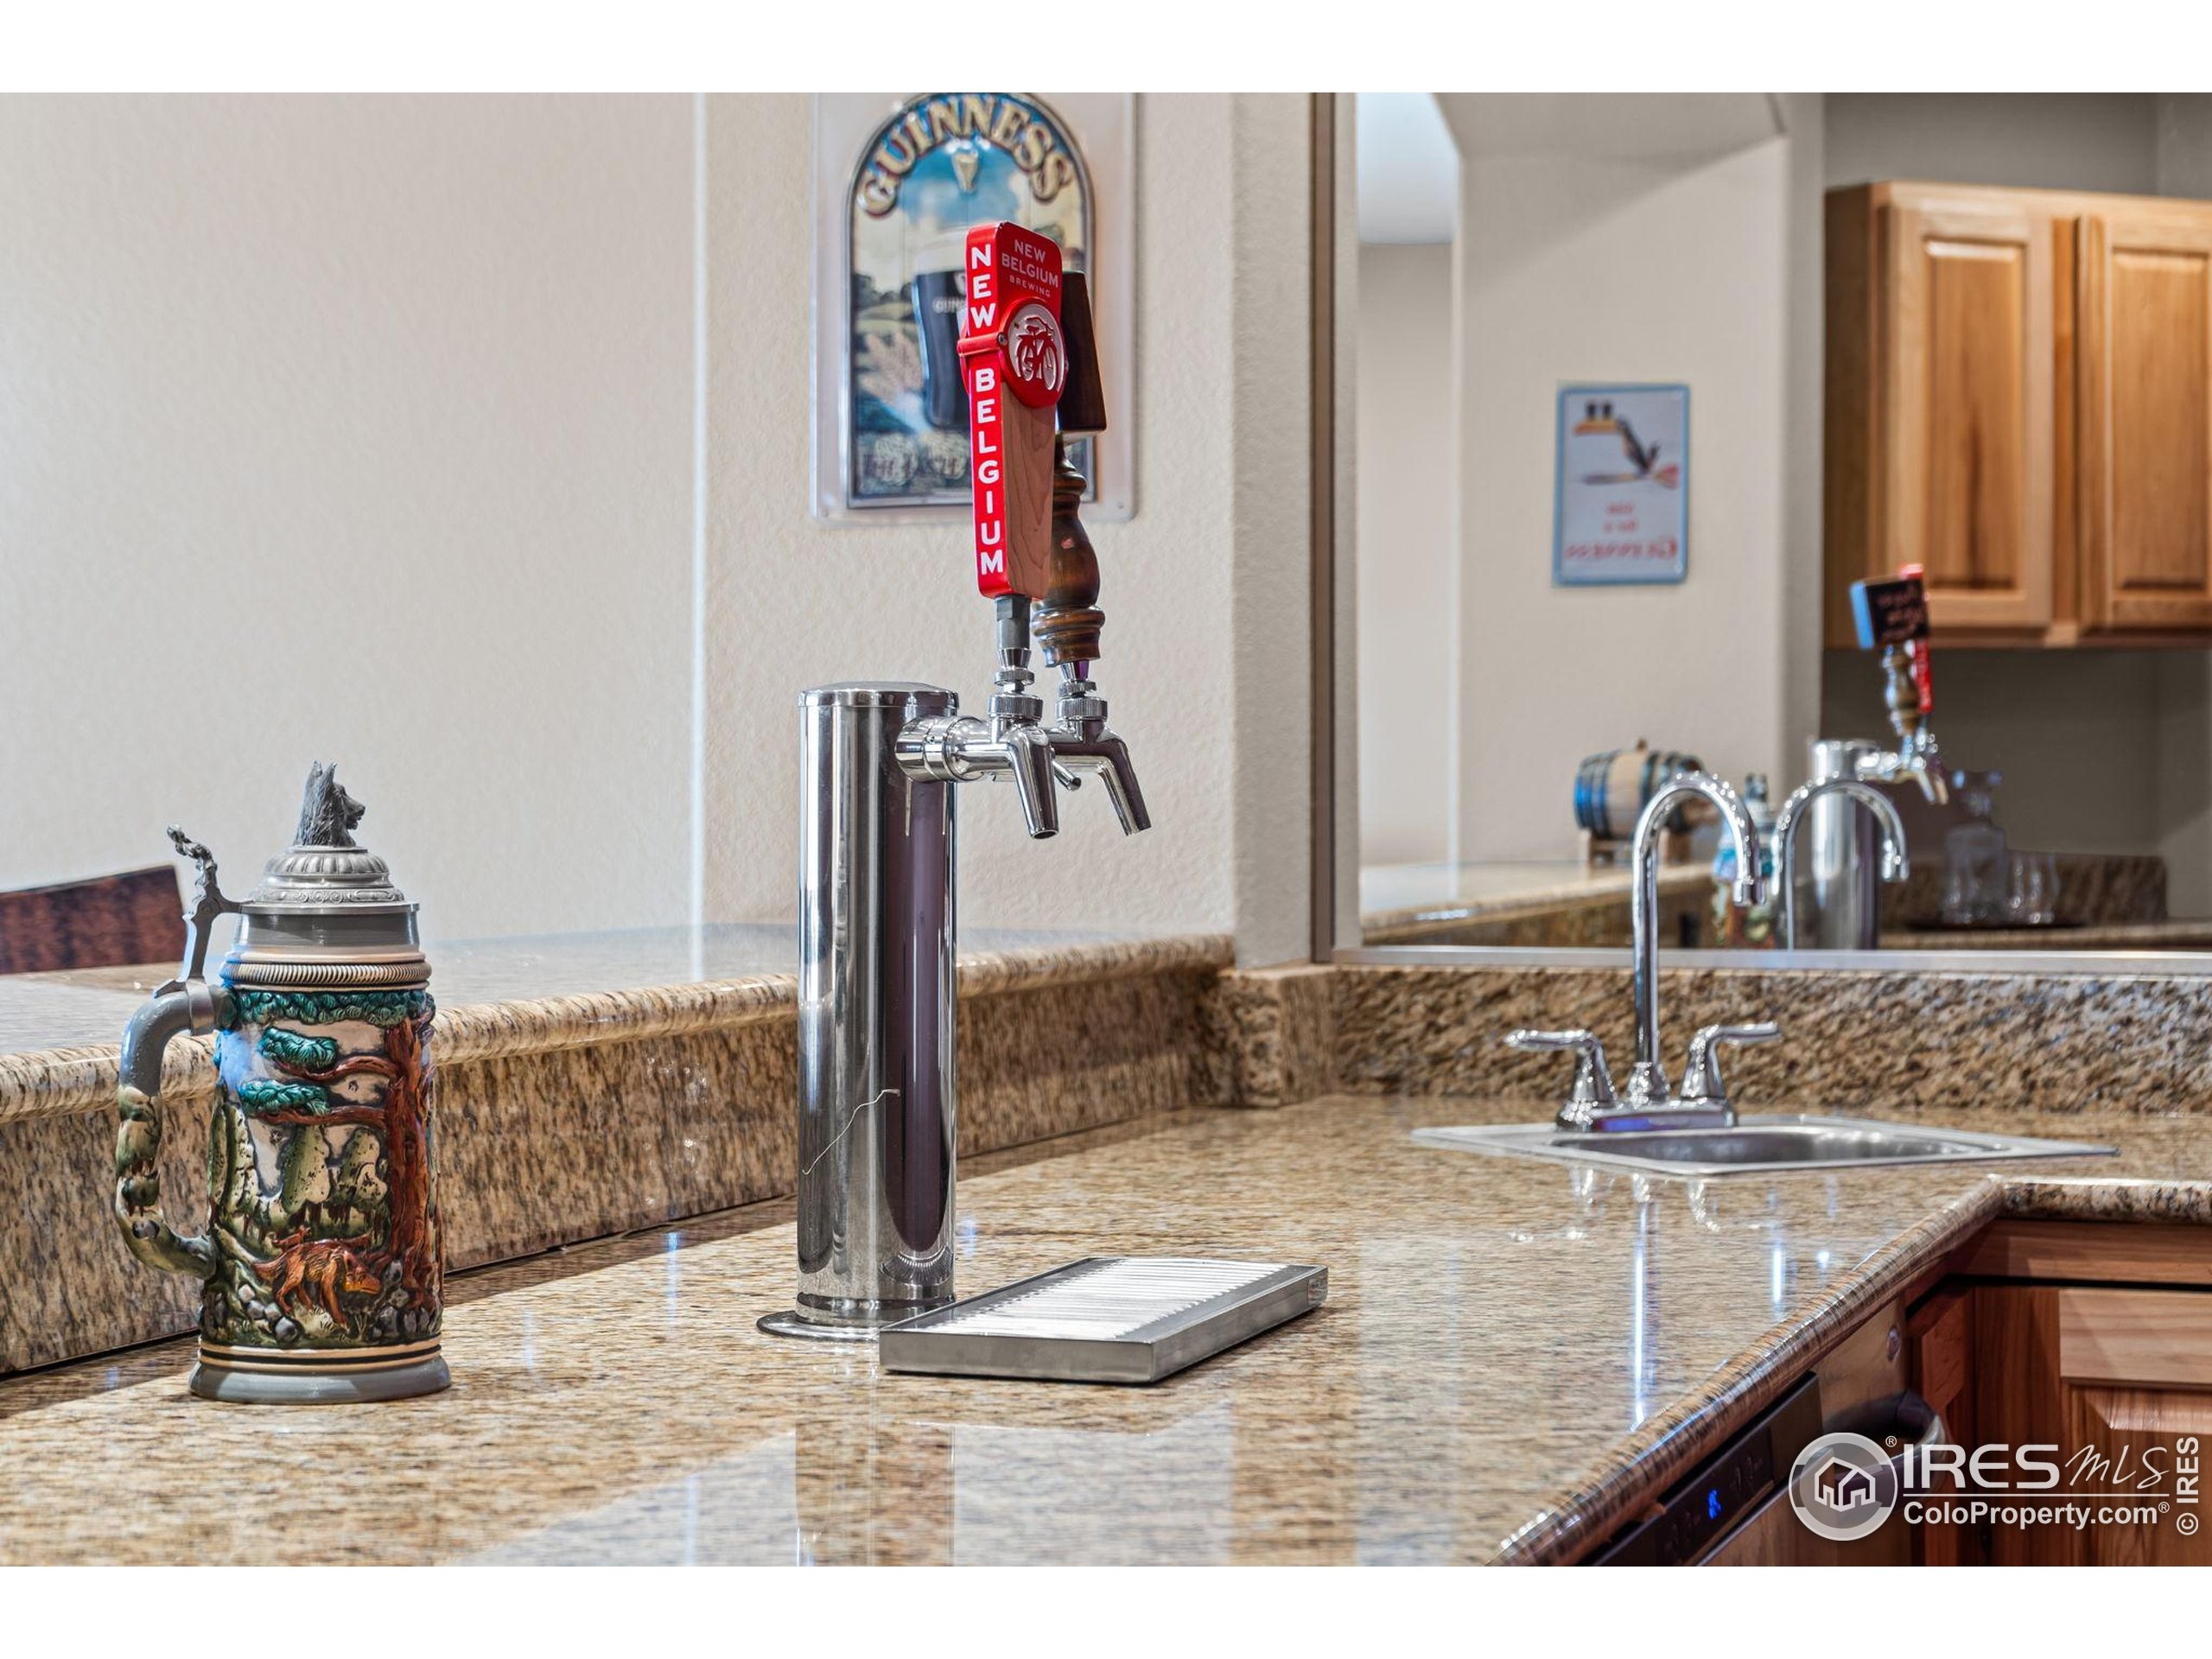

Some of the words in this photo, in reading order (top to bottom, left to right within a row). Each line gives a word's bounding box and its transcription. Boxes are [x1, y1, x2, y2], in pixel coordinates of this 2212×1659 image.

[855, 93, 1073, 218] GUINNESS
[1001, 252, 1058, 289] BELGIUM
[1014, 239, 1046, 264] NEW
[970, 244, 996, 329] NEW
[1009, 275, 1051, 298] BREWING
[976, 368, 1004, 575] BELGIUM
